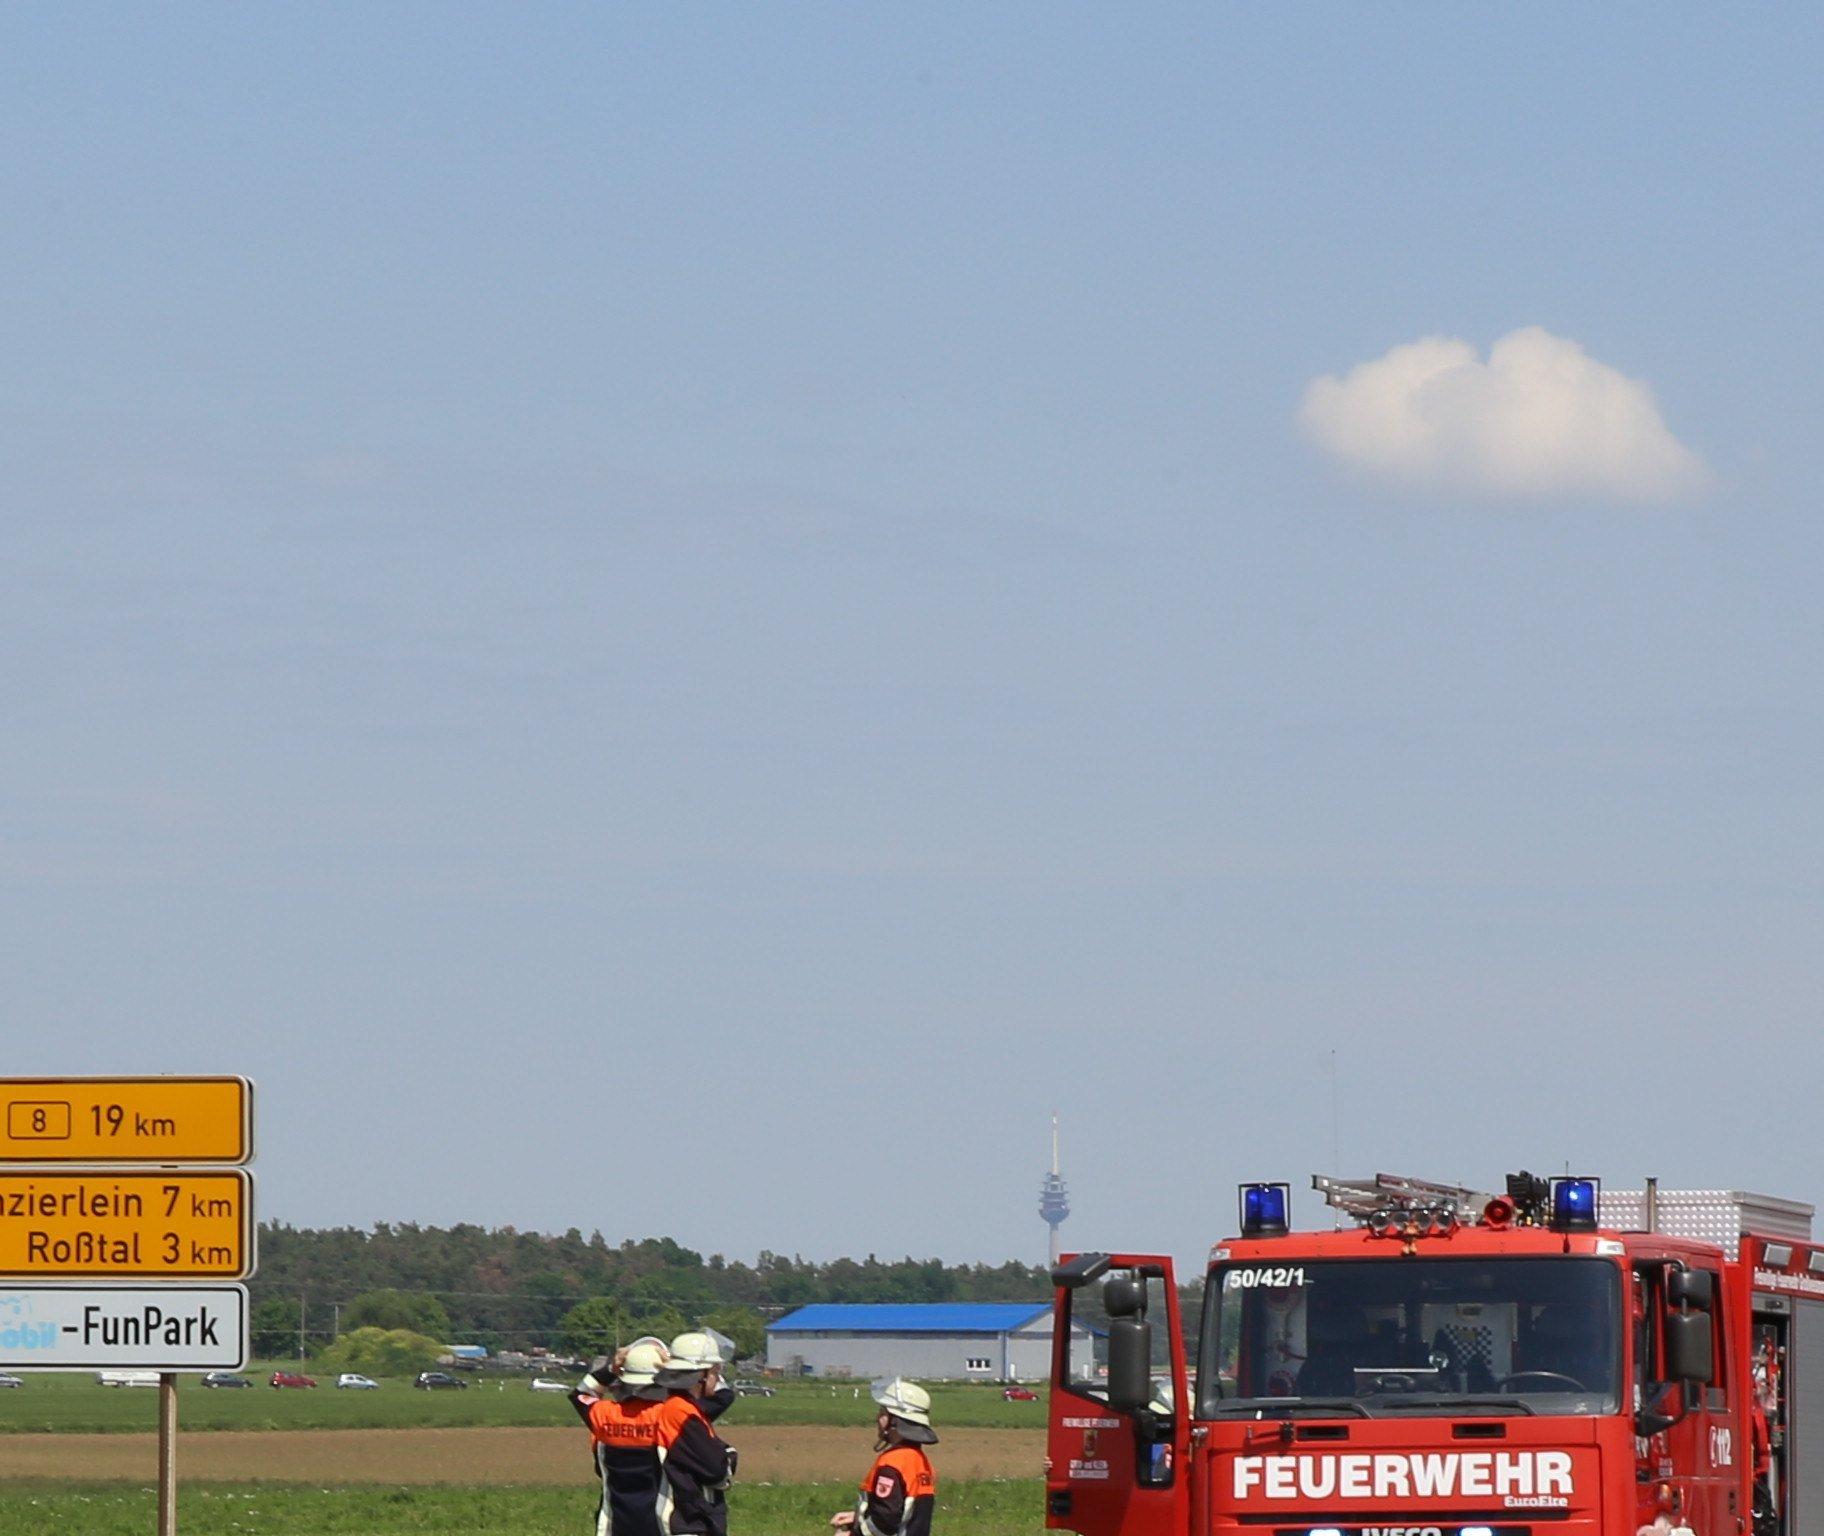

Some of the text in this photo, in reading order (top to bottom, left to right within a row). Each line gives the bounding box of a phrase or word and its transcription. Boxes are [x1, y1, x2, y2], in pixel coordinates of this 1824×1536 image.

[31, 1109, 47, 1133] 8
[91, 1105, 124, 1137] 19
[135, 1112, 177, 1137] km
[161, 1186, 181, 1217] 7
[191, 1192, 233, 1218] km
[27, 1231, 233, 1264] Roßtal 3 km
[1230, 1268, 1305, 1290] 50/42/1
[61, 1306, 219, 1346] -FunPark
[1232, 1451, 1575, 1499] FEUERWEHR
